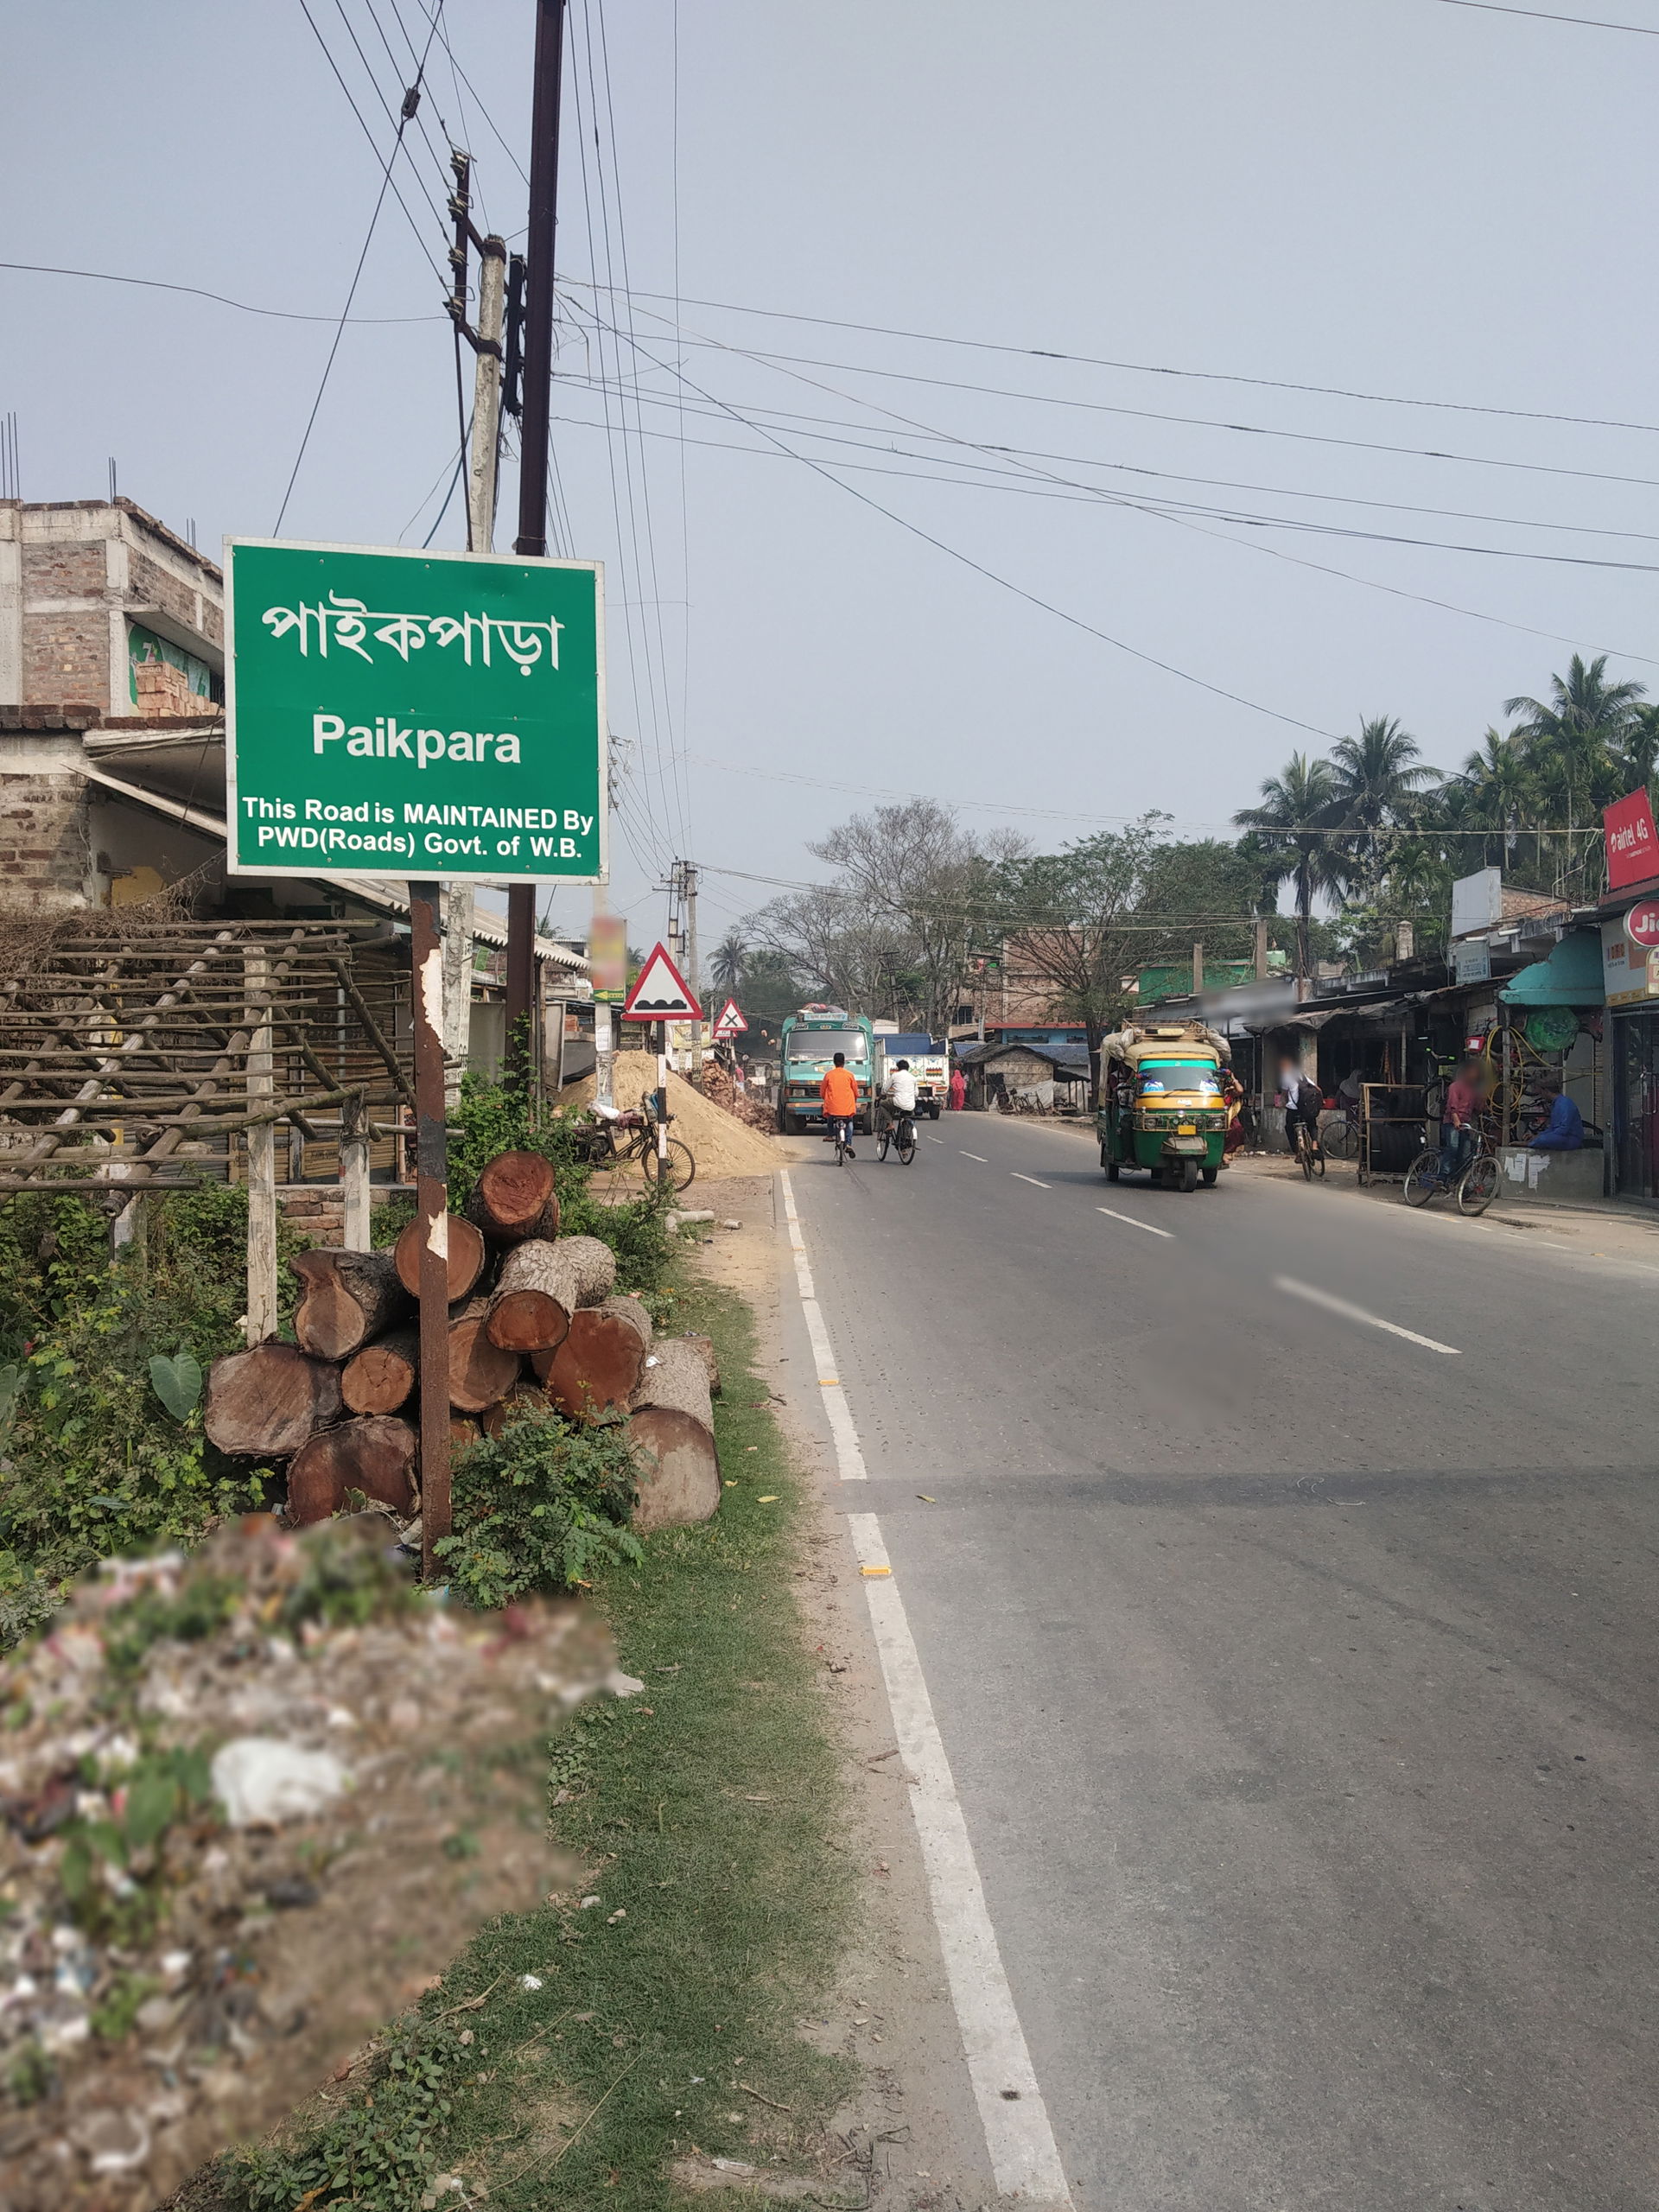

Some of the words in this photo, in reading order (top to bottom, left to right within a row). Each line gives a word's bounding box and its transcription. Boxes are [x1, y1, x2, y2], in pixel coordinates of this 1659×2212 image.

[261, 588, 565, 676] পাইকপাড়া
[313, 714, 521, 769] Paikpara
[242, 797, 296, 819] This
[305, 798, 369, 823] Road
[374, 802, 395, 823] is
[404, 803, 557, 830] MAINTAINED
[563, 809, 594, 836] By
[1617, 823, 1637, 851] airtel
[1637, 817, 1649, 841] 4G
[257, 826, 416, 858] PWD(Roads)
[424, 832, 487, 855] Govt.
[496, 836, 520, 856] of
[530, 836, 582, 858] W.B.
[1635, 912, 1659, 933] Ji
